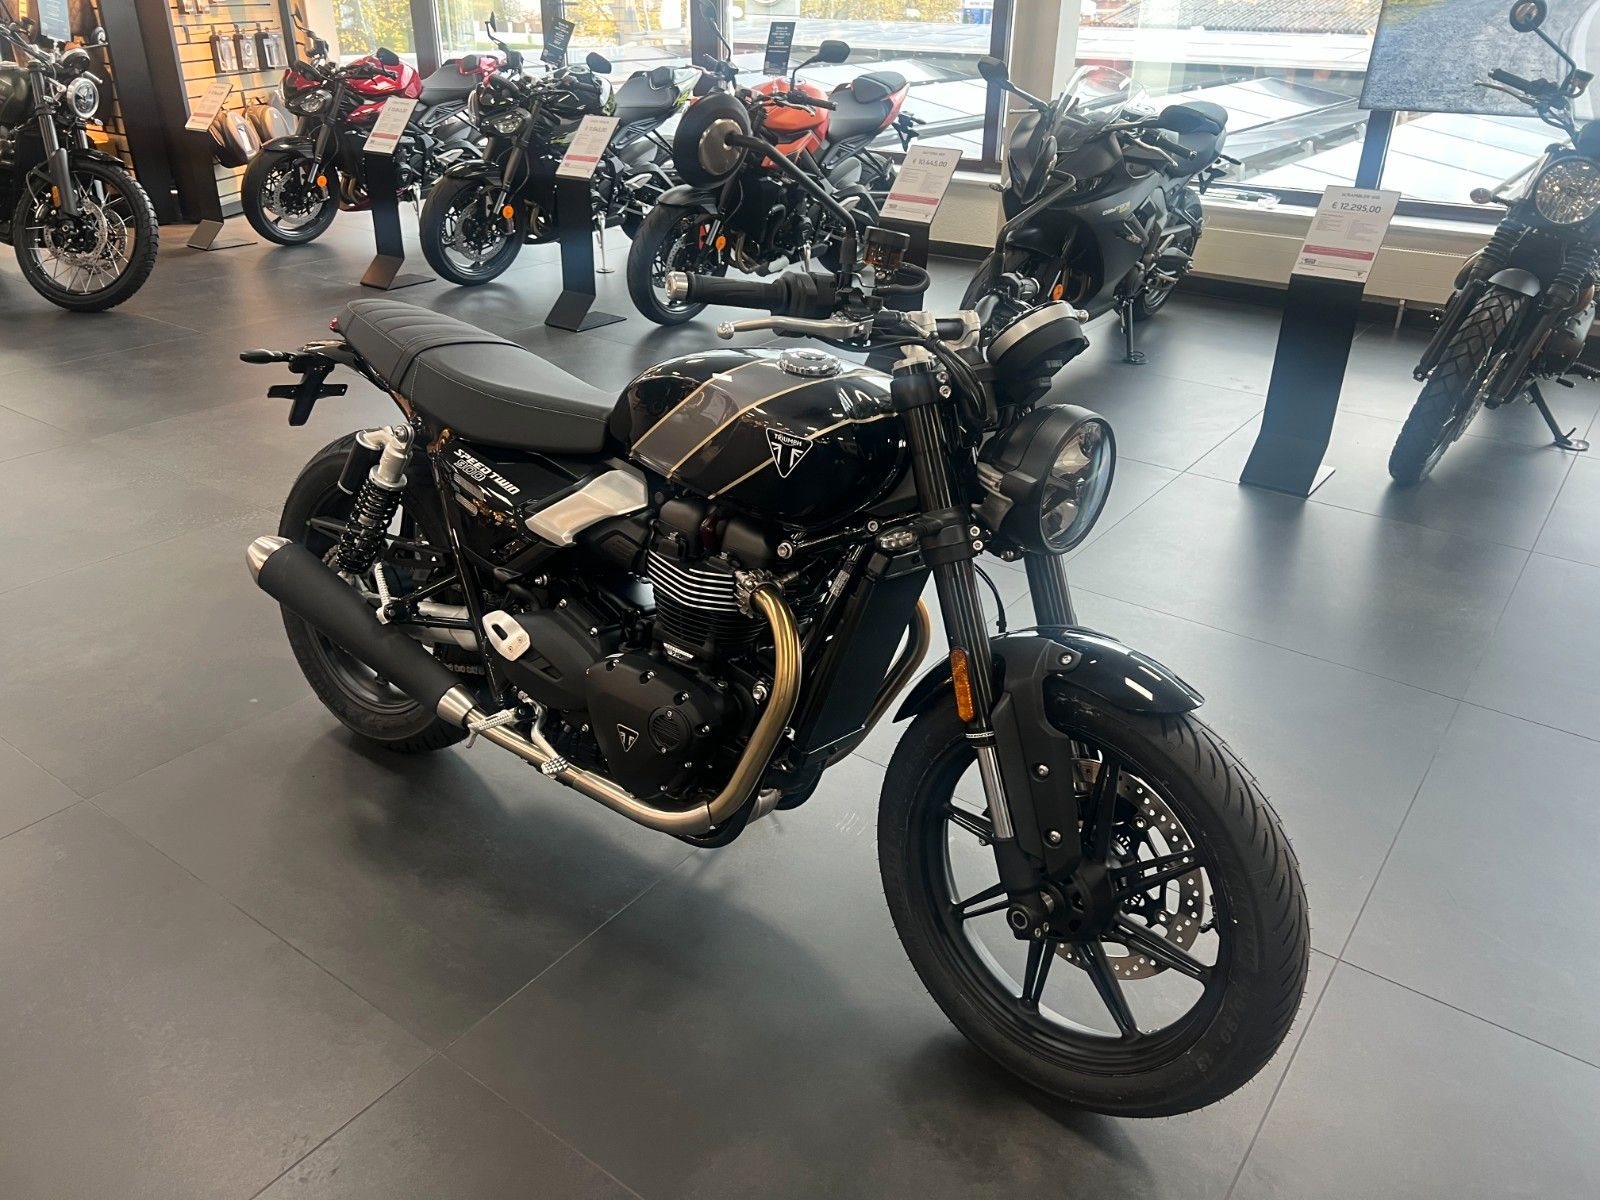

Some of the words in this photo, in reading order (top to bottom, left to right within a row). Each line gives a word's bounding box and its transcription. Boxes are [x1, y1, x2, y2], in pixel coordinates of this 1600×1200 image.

[1331, 201, 1339, 209] €
[1340, 202, 1381, 213] 12.295,00
[774, 433, 802, 447] TRIUMPH
[453, 459, 486, 482] 900
[453, 448, 492, 475] SPEED
[489, 472, 521, 495] TWIN
